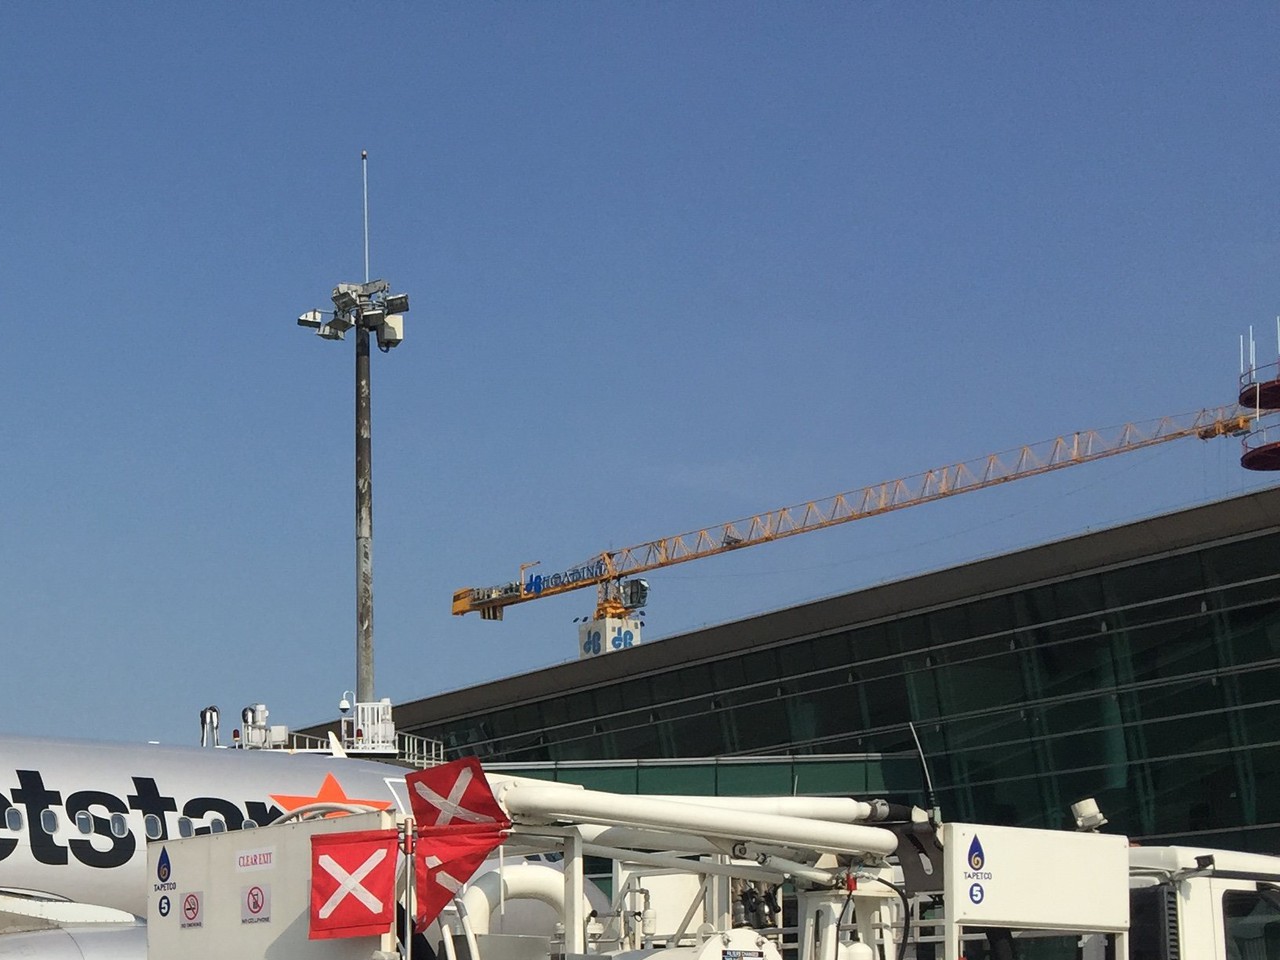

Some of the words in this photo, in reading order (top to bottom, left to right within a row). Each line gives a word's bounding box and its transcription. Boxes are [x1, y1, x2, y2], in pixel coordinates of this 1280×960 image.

[238, 853, 258, 868] CLEAR
[258, 851, 273, 866] EXIT
[963, 872, 993, 881] TAPETCO
[154, 882, 177, 892] TAPETCO
[972, 886, 982, 902] 5
[160, 898, 169, 915] 5
